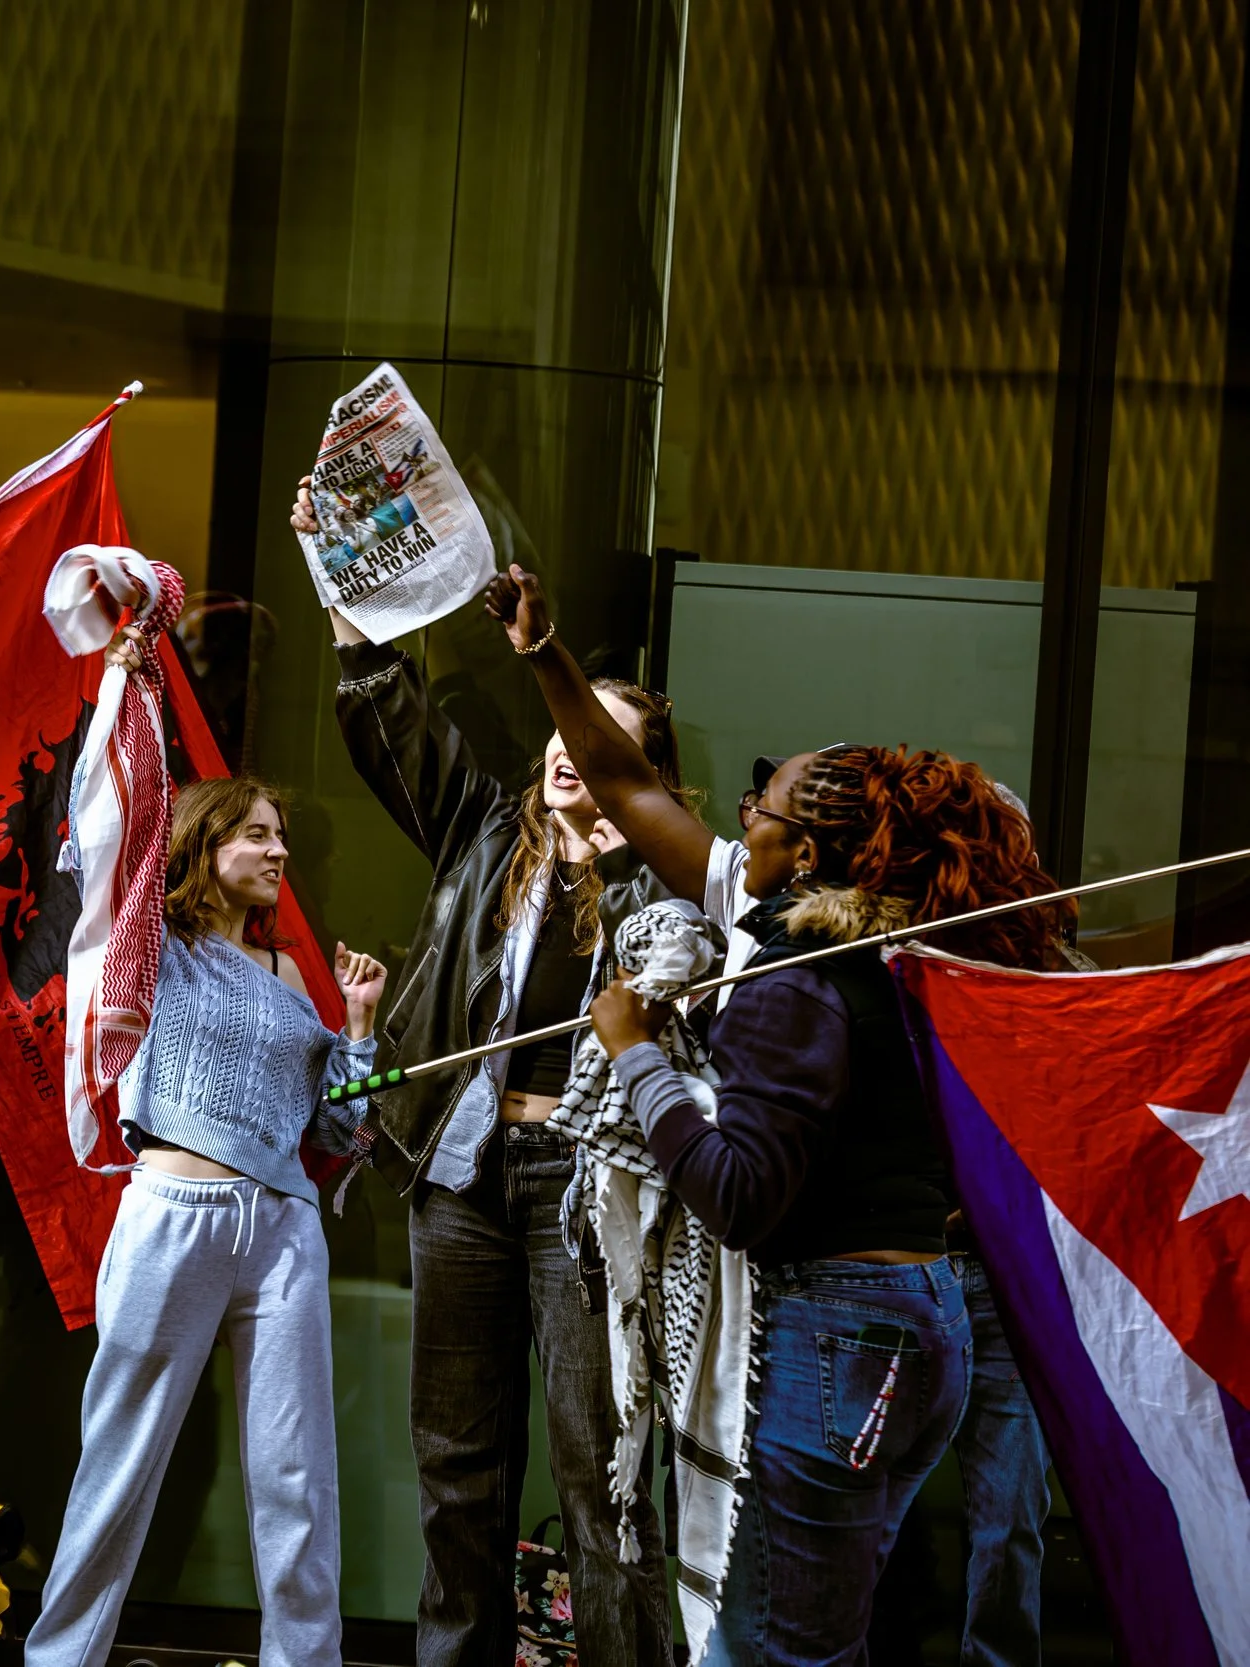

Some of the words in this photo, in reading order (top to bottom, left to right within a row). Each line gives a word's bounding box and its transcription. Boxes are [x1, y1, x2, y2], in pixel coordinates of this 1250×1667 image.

[320, 475, 339, 491] TO
[341, 452, 379, 481] FIGHT
[360, 441, 373, 456] A
[330, 562, 363, 588] WE
[363, 531, 411, 569] HAVE
[412, 521, 428, 539] A
[338, 568, 380, 603] DUTY
[380, 555, 403, 575] TO
[402, 534, 437, 562] WIN
[0, 998, 58, 1102] SIEMPRE
